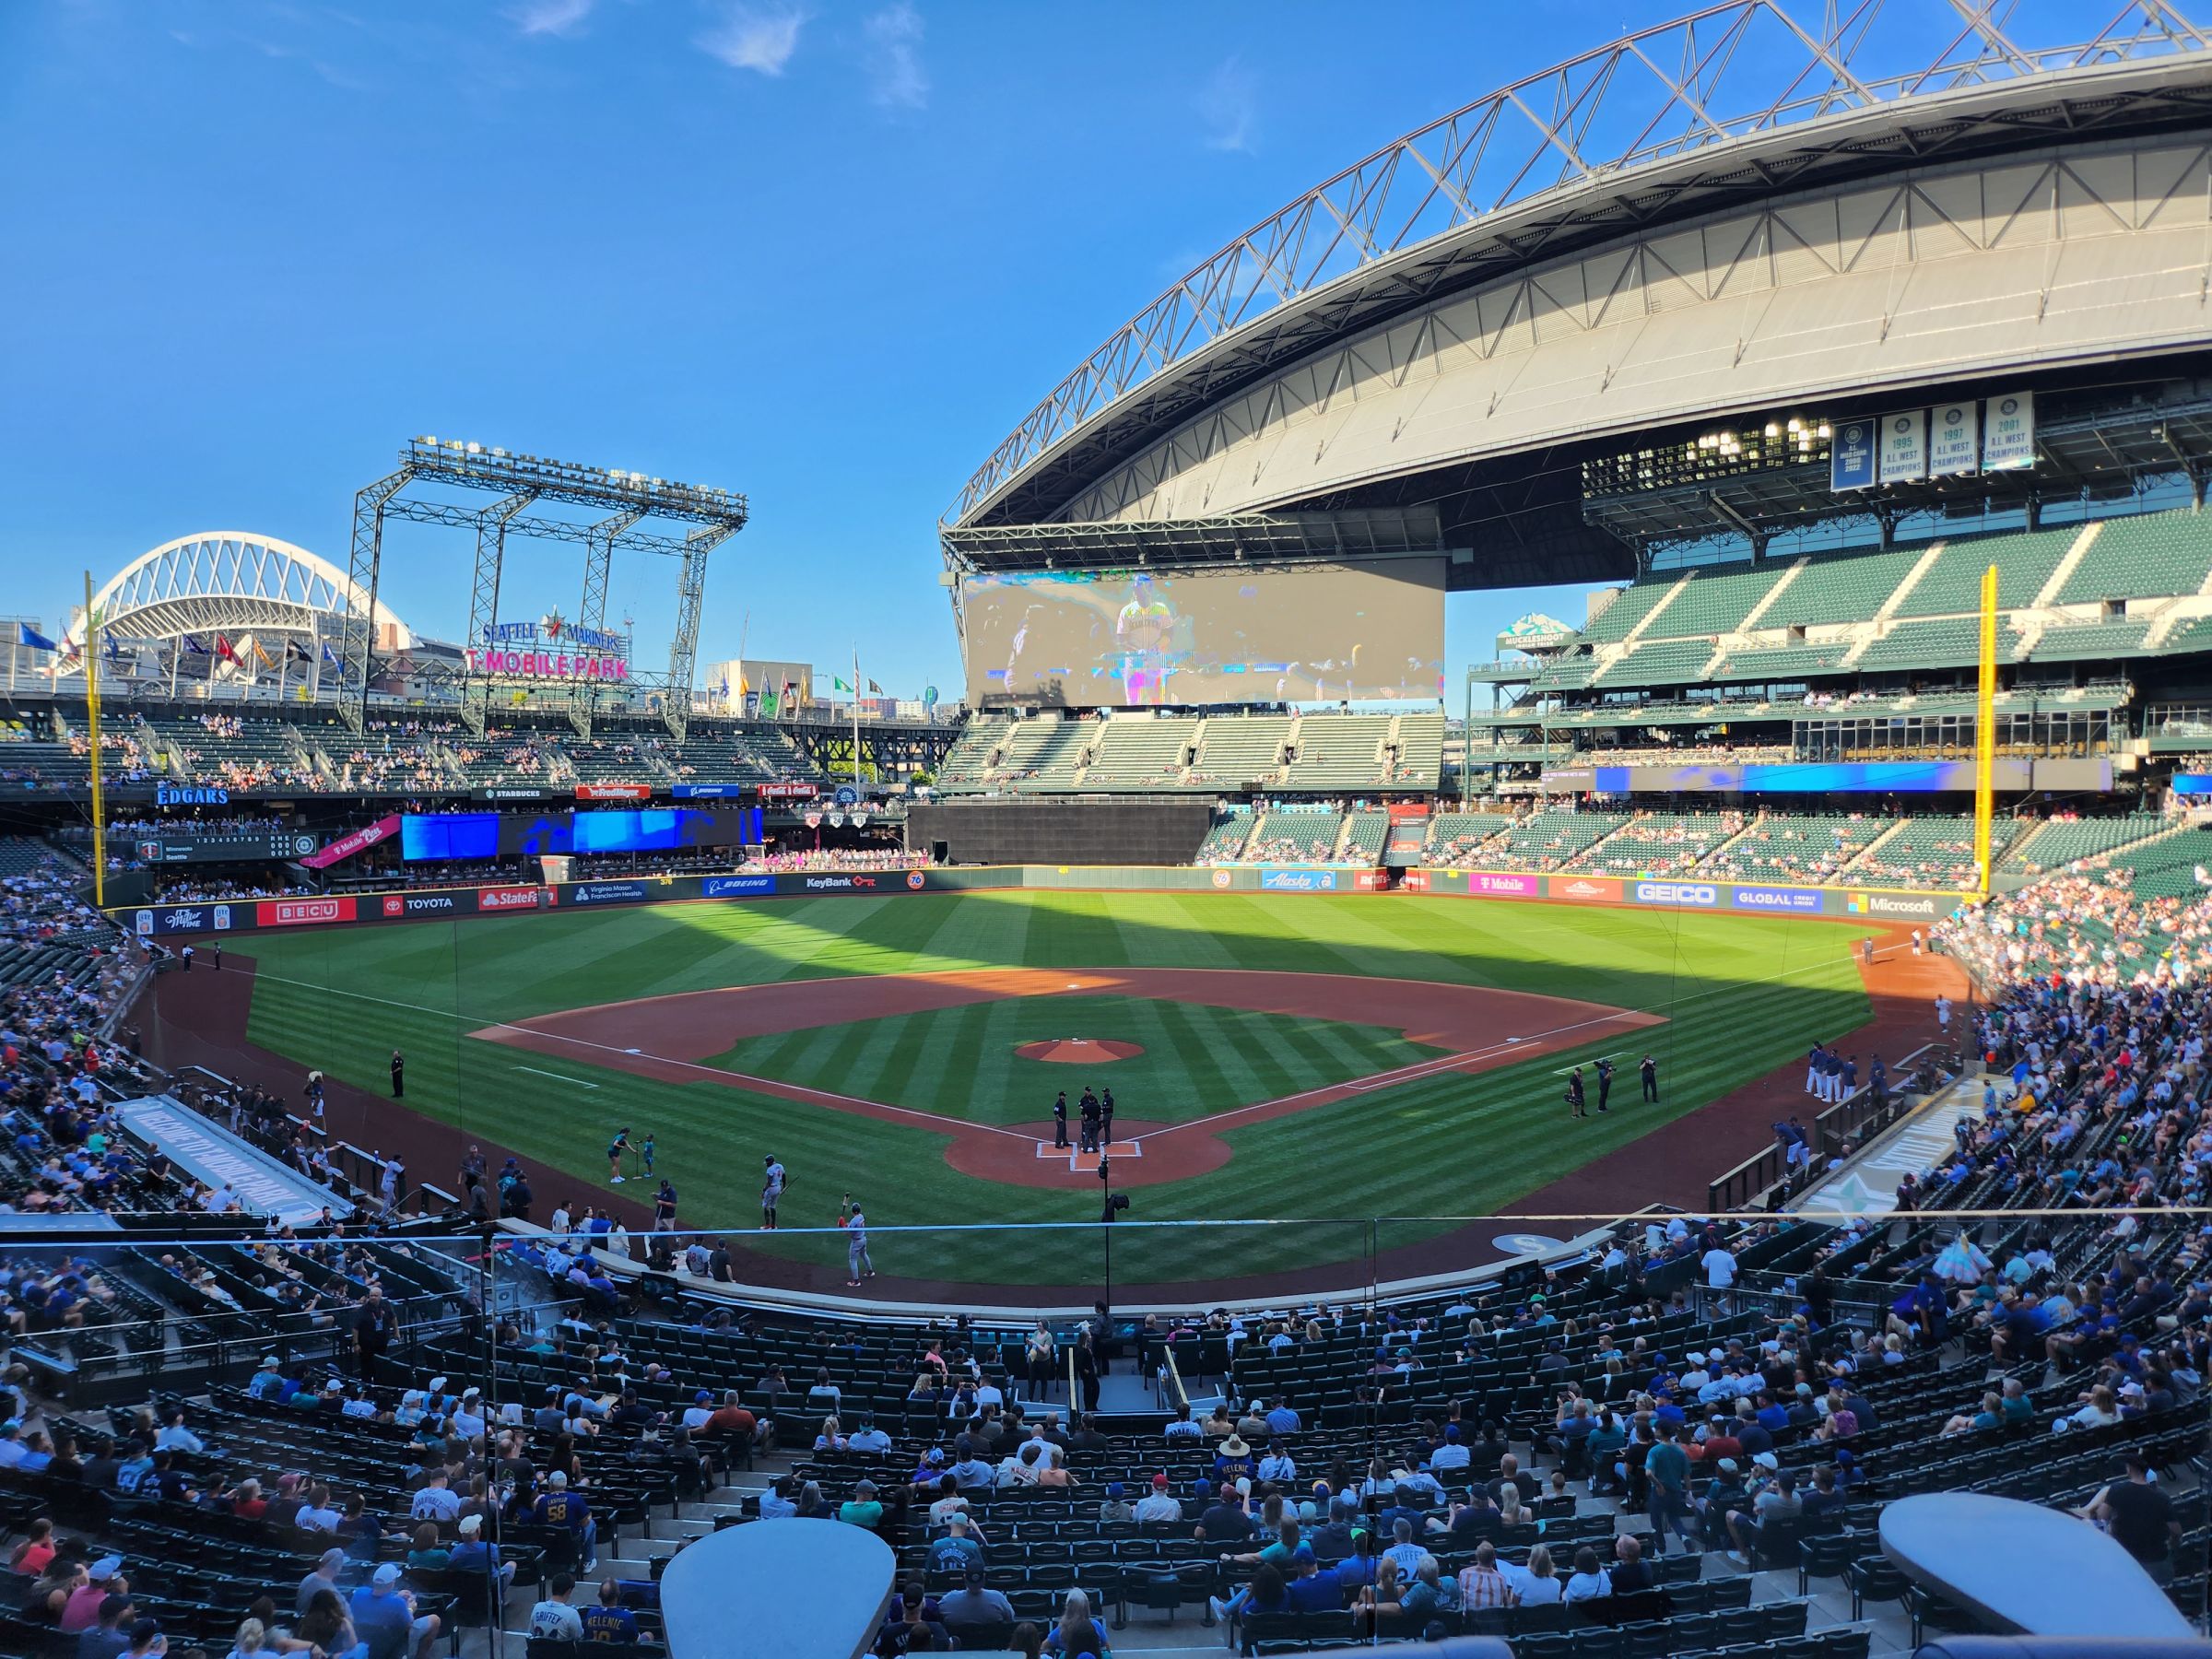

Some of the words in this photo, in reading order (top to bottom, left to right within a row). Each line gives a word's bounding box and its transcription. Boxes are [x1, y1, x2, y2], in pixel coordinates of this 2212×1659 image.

[1998, 419, 2019, 432] 2001
[1944, 429, 1963, 441] 1997
[2006, 432, 2026, 444] WEST
[1893, 437, 1912, 450] 1995
[1950, 441, 1970, 453] WEST
[1900, 450, 1918, 461] WEST
[1986, 445, 2030, 460] CHAMPIONS
[1933, 453, 1973, 468] CHAMPIONS
[1882, 462, 1922, 476] CHAMPIONS
[483, 623, 536, 643] SEATTLE
[566, 624, 620, 653] MARINERS
[1505, 633, 1565, 645] MUCKLESHOOT
[465, 649, 569, 676] T-MOBILE
[574, 655, 629, 678] PARK
[724, 879, 769, 888] BOEING
[806, 877, 853, 889] KeyBank
[1217, 874, 1227, 882] 76
[1265, 873, 1312, 888] Alaska
[590, 886, 612, 894] Virginia
[1637, 884, 1715, 903] GEICO
[407, 898, 453, 910] TOYOTA
[1739, 892, 1791, 905] GLOBAL
[1870, 898, 1934, 913] Microsoft
[165, 912, 202, 928] Miller
[182, 920, 201, 928] TIME
[1222, 1464, 1250, 1475] KELENIC
[547, 1504, 566, 1522] 58
[535, 1611, 563, 1625] GRIFFEY
[588, 1617, 624, 1630] KELENIC
